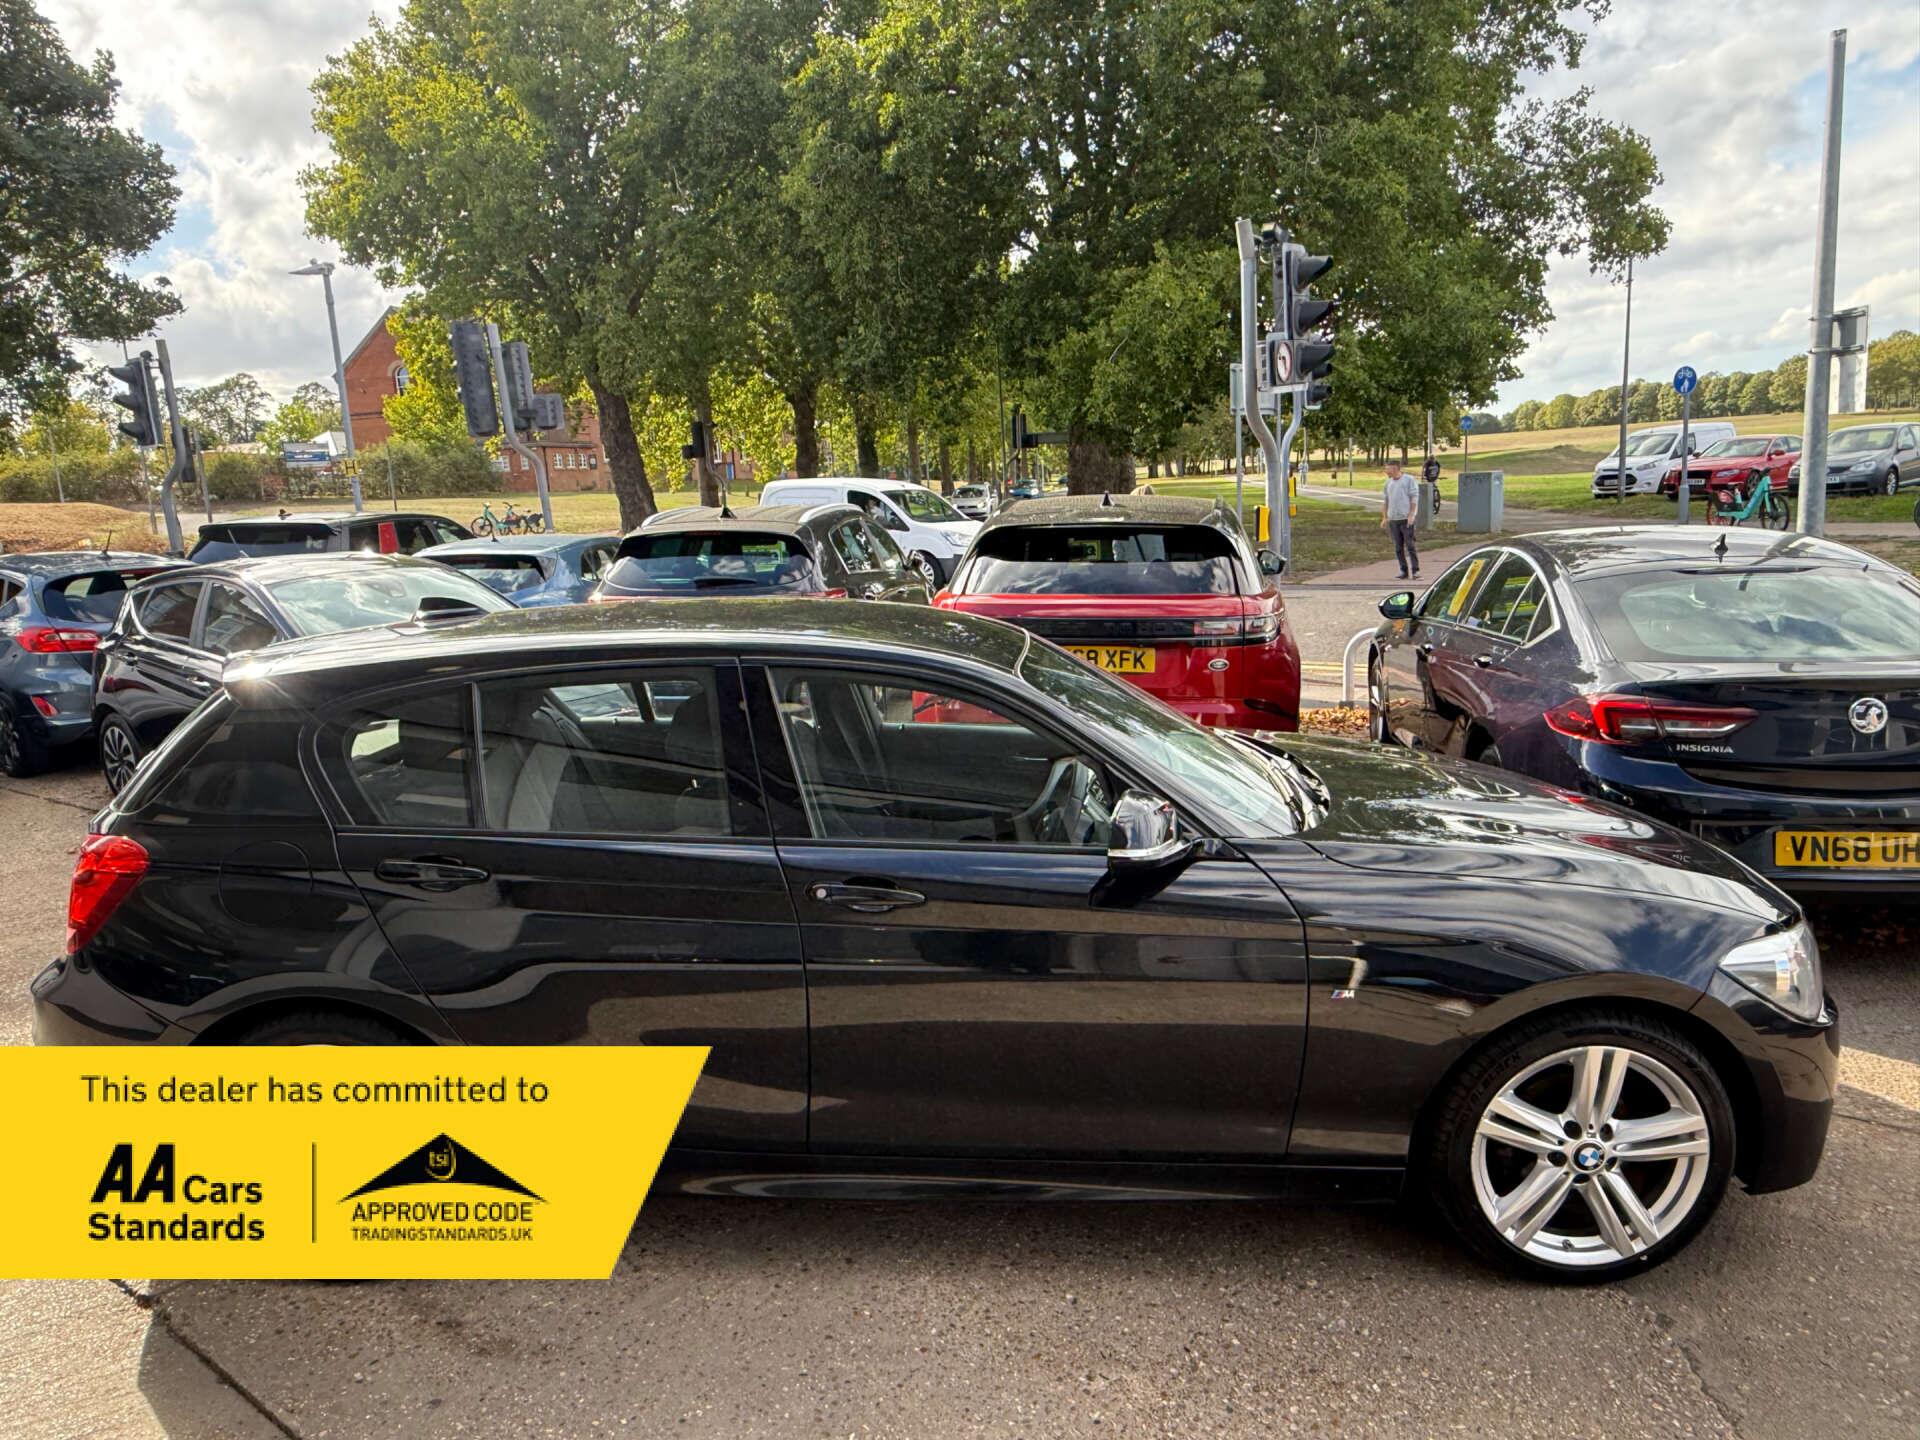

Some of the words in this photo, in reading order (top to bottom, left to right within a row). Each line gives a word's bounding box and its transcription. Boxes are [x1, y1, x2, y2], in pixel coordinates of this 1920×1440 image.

[1105, 649, 1146, 669] XFK
[1676, 743, 1734, 754] INSIGNIA
[1790, 835, 1871, 863] VN68
[1881, 836, 1920, 863] UH
